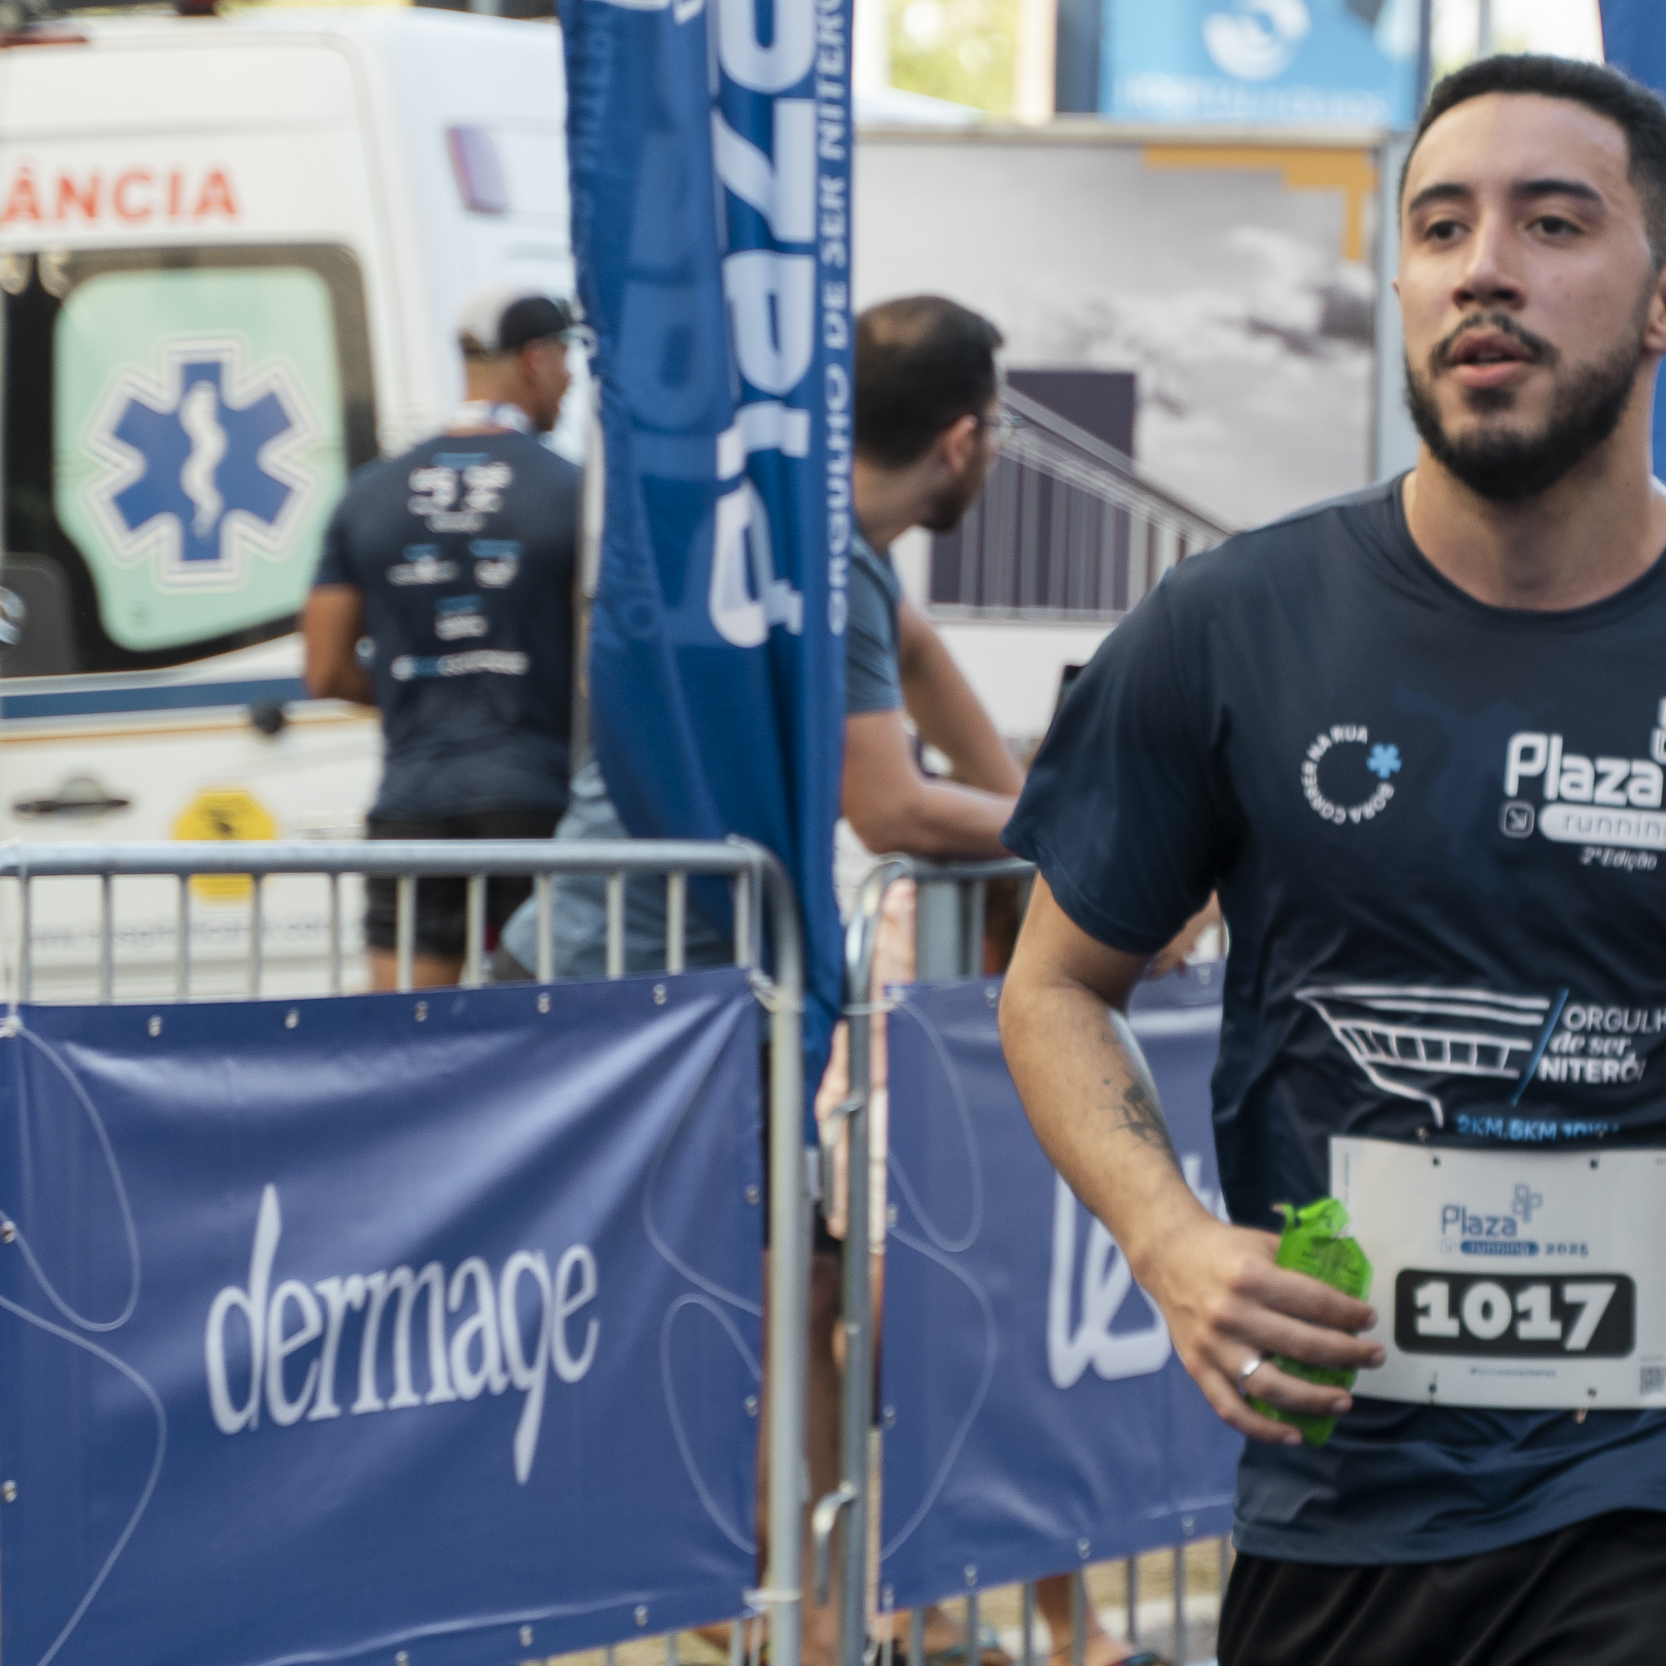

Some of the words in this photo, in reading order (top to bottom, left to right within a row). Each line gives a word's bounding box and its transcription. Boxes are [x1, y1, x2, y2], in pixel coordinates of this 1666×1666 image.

[817, 171, 848, 269] SER
[820, 280, 849, 351] DE
[1306, 733, 1334, 763] NA
[1329, 723, 1369, 745] RUA
[1503, 729, 1666, 810] Plaza
[1300, 759, 1347, 826] CORRER
[1348, 780, 1396, 825] BORA
[1550, 1030, 1587, 1055] de
[1536, 1051, 1649, 1084] NITERÓI
[1441, 1203, 1519, 1237] Plaza
[1414, 1279, 1618, 1353] 1017
